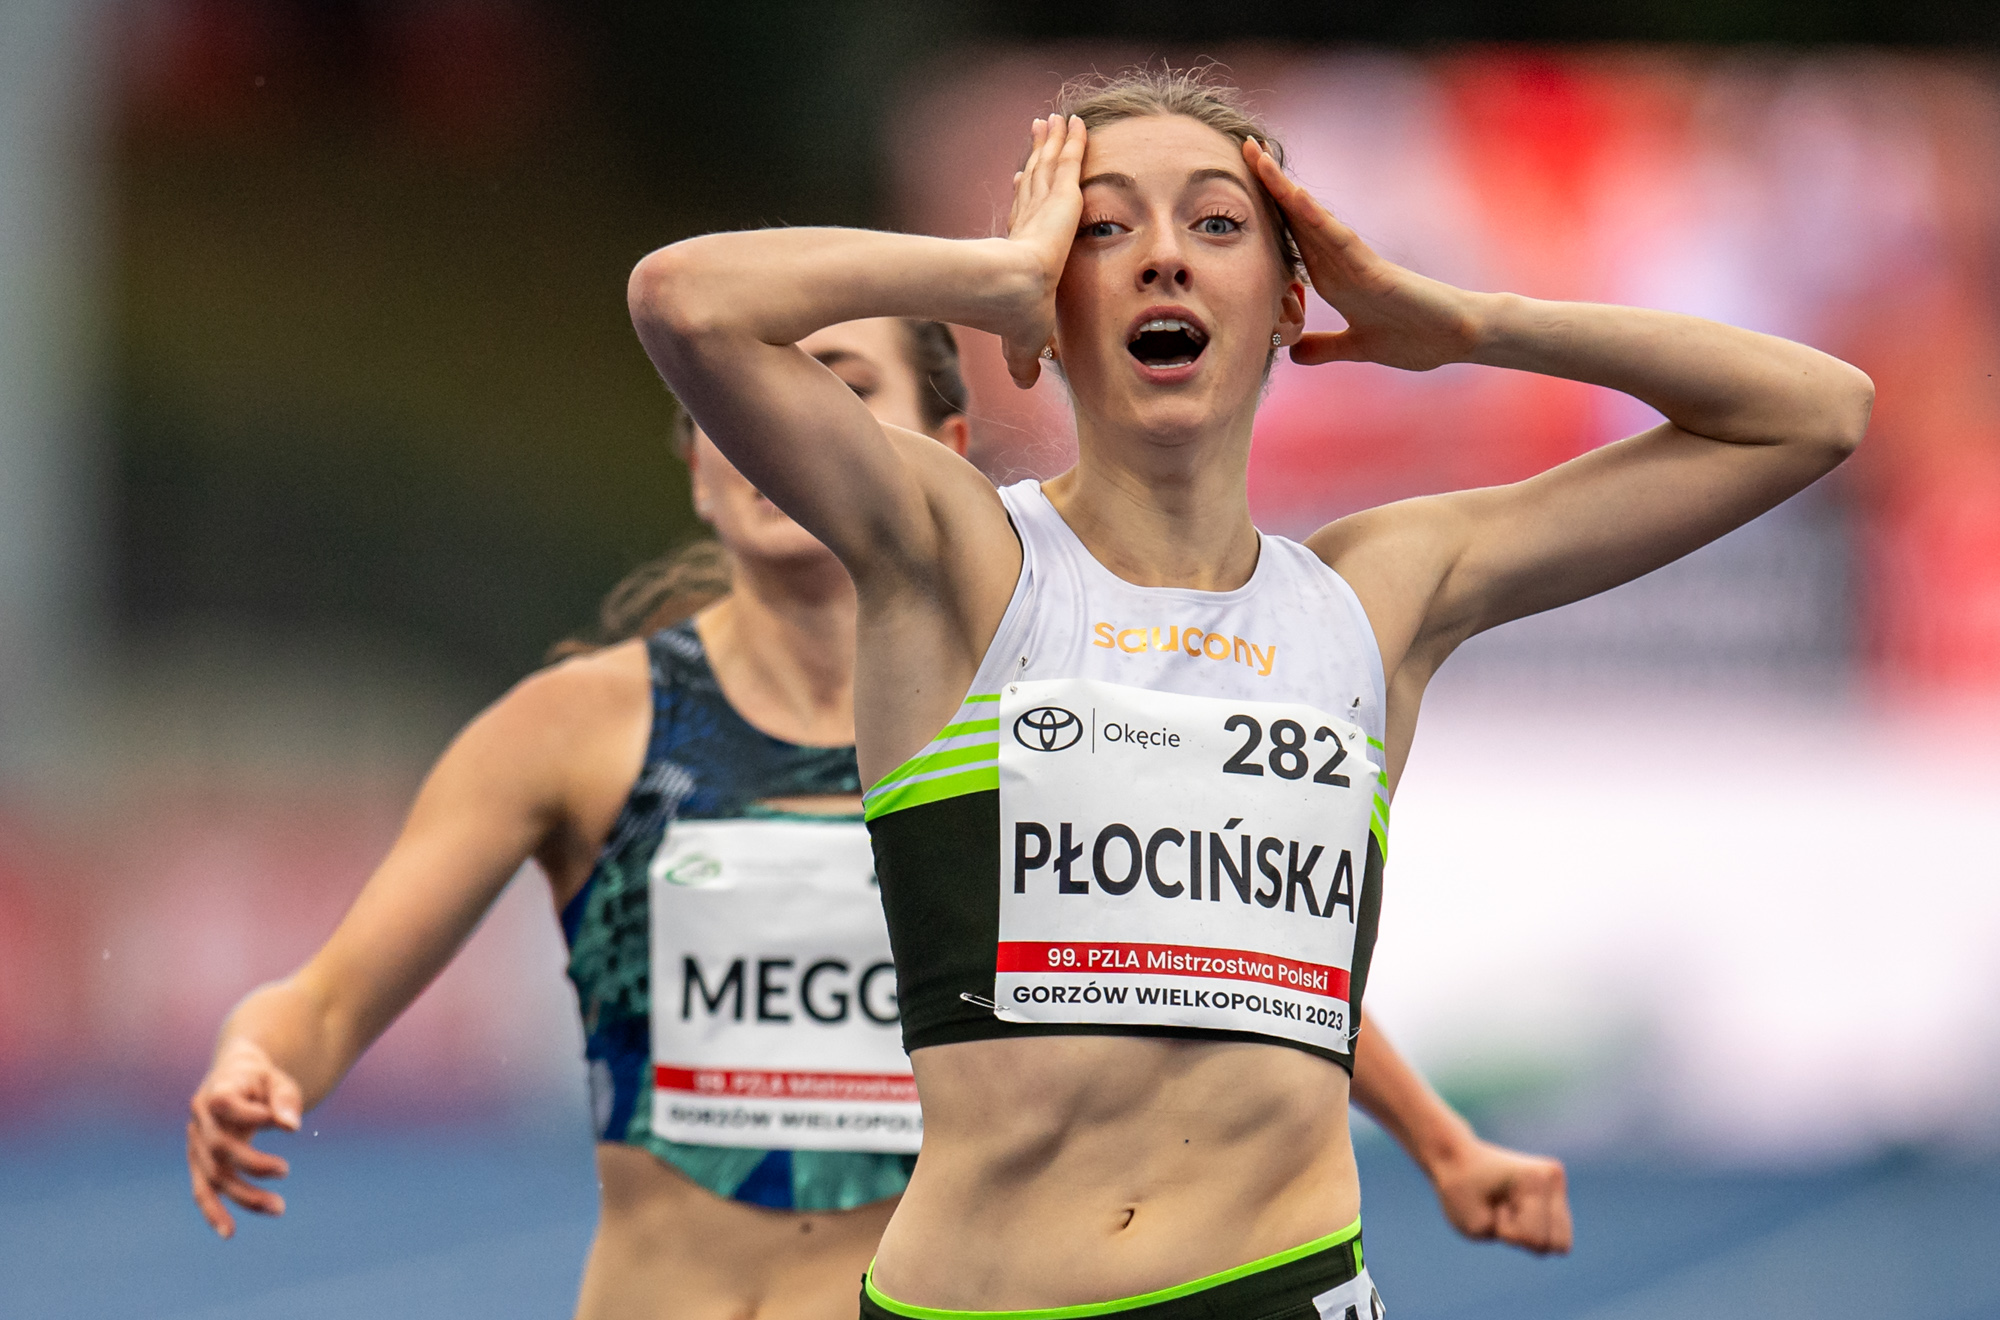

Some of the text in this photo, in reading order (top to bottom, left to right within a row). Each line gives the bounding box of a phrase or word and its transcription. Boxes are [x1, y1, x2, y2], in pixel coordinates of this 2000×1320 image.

[1092, 621, 1277, 677] saucony
[1103, 722, 1181, 749] Okęcie
[1222, 714, 1351, 789] 282
[1013, 817, 1355, 924] PŁOCIŃSKA
[1047, 948, 1329, 991] 99. PZLA Mistrzostwa Polski
[1012, 980, 1344, 1031] GORZÓW WIELKOPOLSKI 2023
